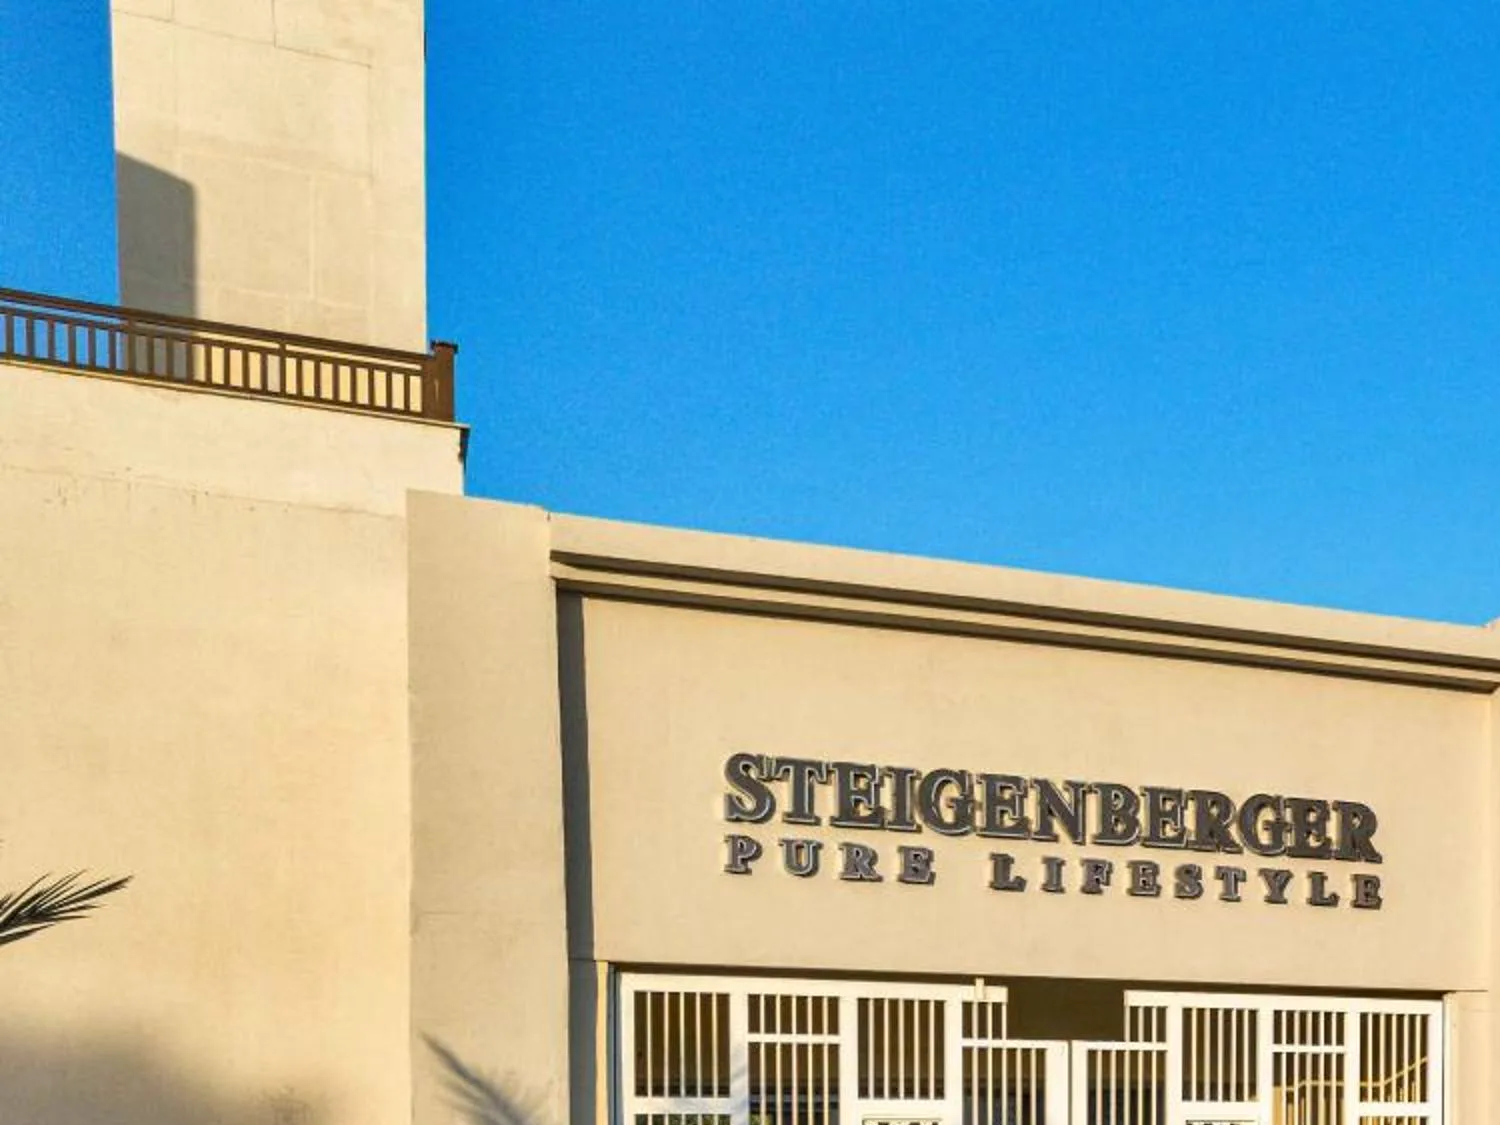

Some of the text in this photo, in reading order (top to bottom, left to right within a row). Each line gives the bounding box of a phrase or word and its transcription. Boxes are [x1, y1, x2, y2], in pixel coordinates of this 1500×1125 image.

[724, 753, 1382, 863] STEIGENBERGER
[724, 834, 1382, 909] PURE LIFESTYLE
